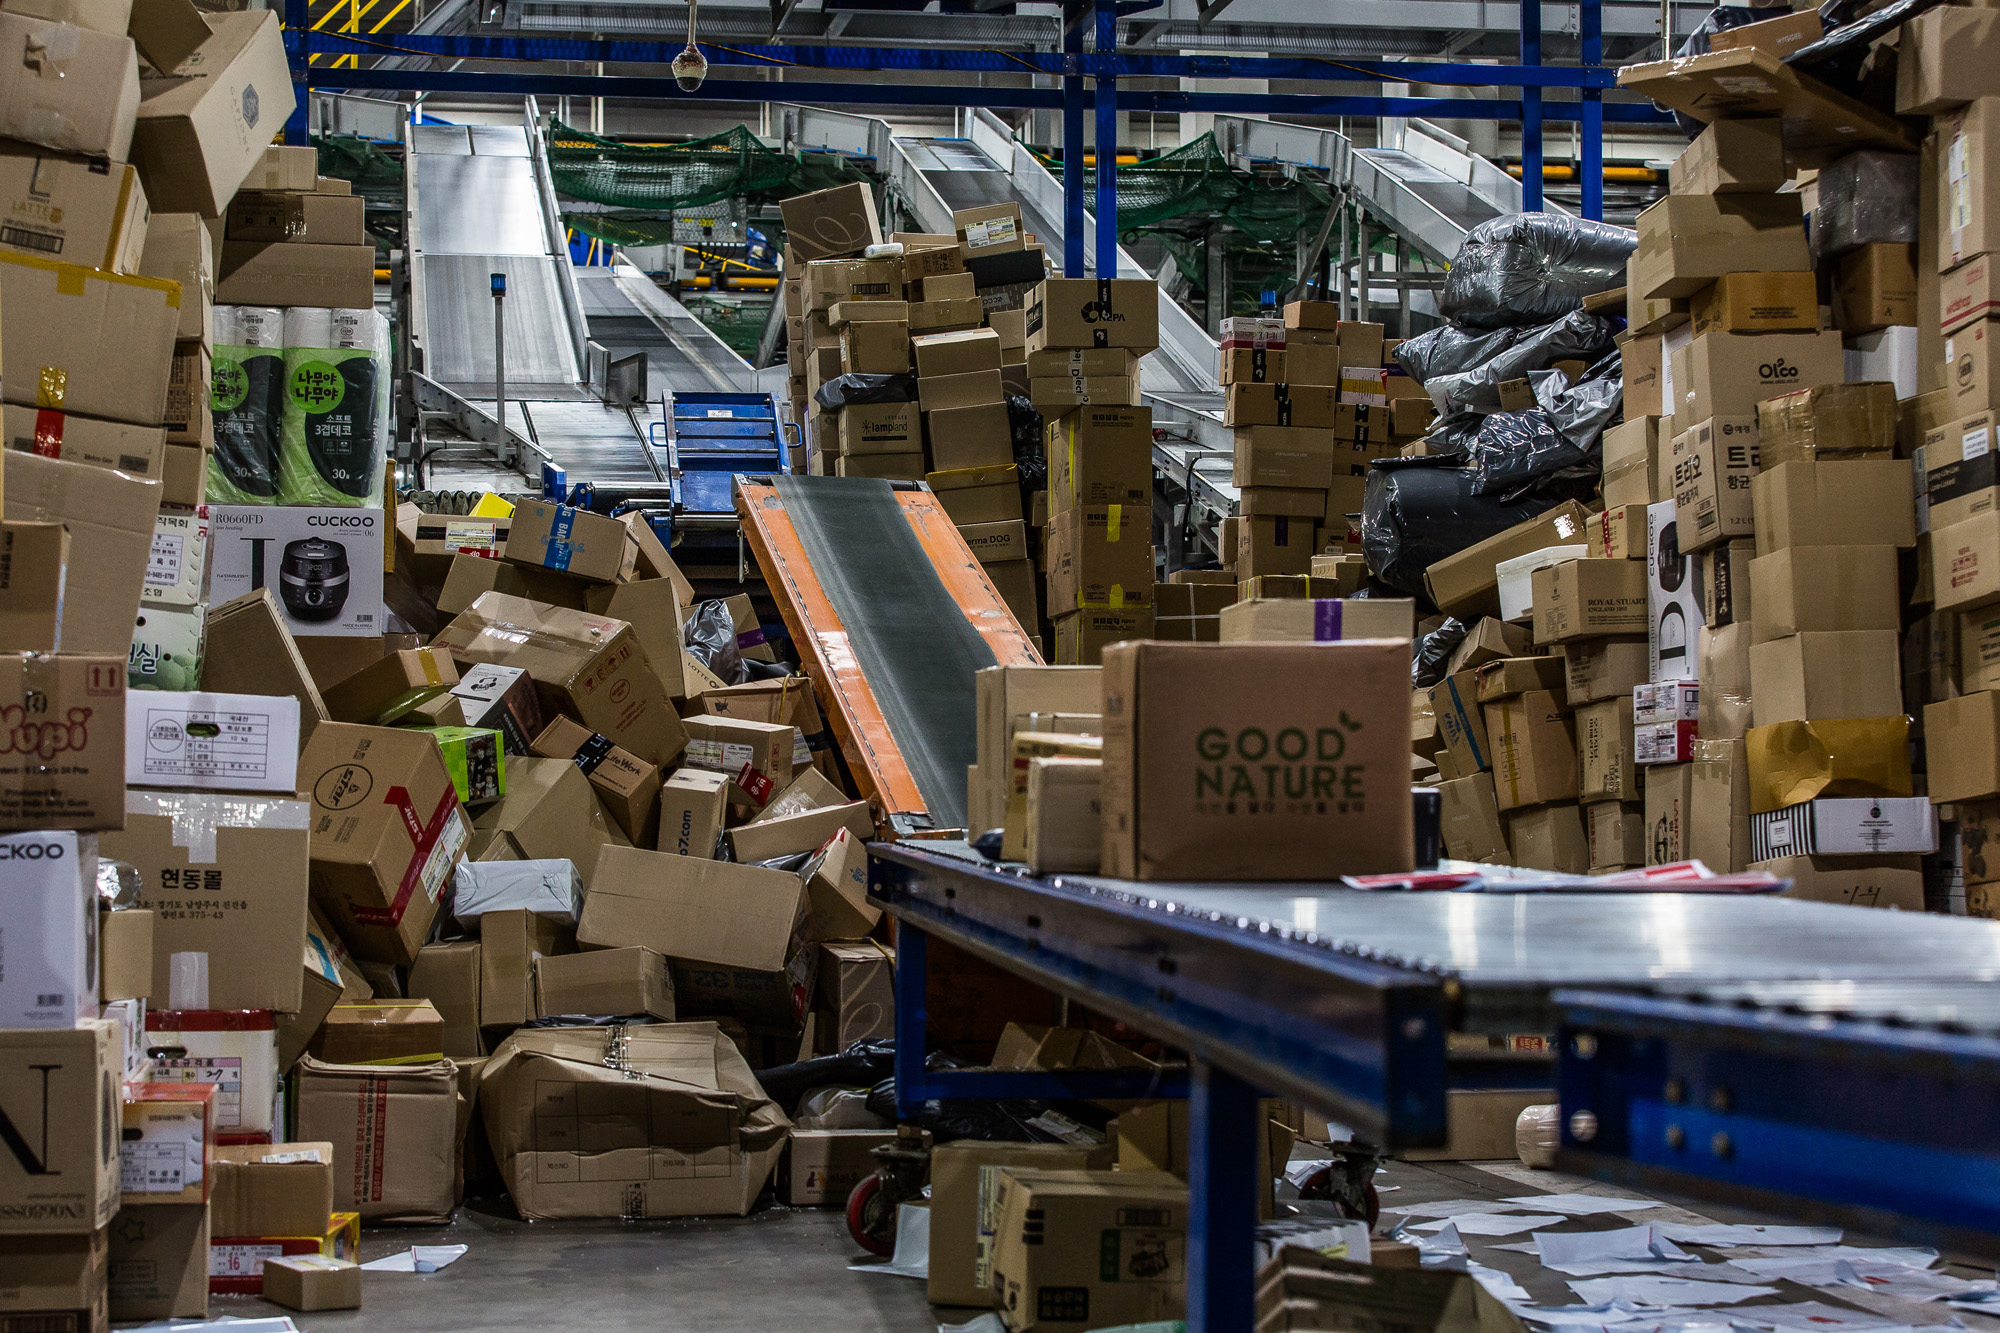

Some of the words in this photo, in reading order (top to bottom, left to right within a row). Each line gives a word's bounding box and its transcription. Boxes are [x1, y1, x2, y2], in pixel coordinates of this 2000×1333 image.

[1776, 32, 1802, 44] HYGGEE
[982, 296, 1003, 305] ecco
[297, 369, 333, 386] 나무야
[294, 386, 335, 405] 나무야
[228, 412, 256, 422] 소프트
[325, 414, 353, 424] 소프트
[217, 421, 255, 435] 3겹데코
[314, 424, 353, 437] 3겹데코
[872, 421, 907, 434] lampland
[1735, 425, 1750, 434] 애경
[1675, 454, 1702, 489] 트리오
[1727, 475, 1752, 490] 항균
[215, 513, 264, 524] R0660FD
[306, 515, 375, 527] CUCKOO
[989, 534, 1011, 543] DOG
[1719, 561, 1727, 599] CRAFT
[1587, 598, 1615, 607] ROYAL
[1615, 597, 1646, 605] STUART
[687, 661, 709, 683] LOTTE
[1196, 726, 1346, 762] GOOD
[750, 776, 767, 797] 반송
[1195, 763, 1366, 799] NATURE
[678, 809, 692, 857] o7.com
[161, 868, 222, 890] 현동몰
[156, 900, 183, 909] 경기도
[185, 900, 219, 910] 남양주시
[189, 911, 224, 919] 375-43
[227, 1256, 240, 1271] 16
